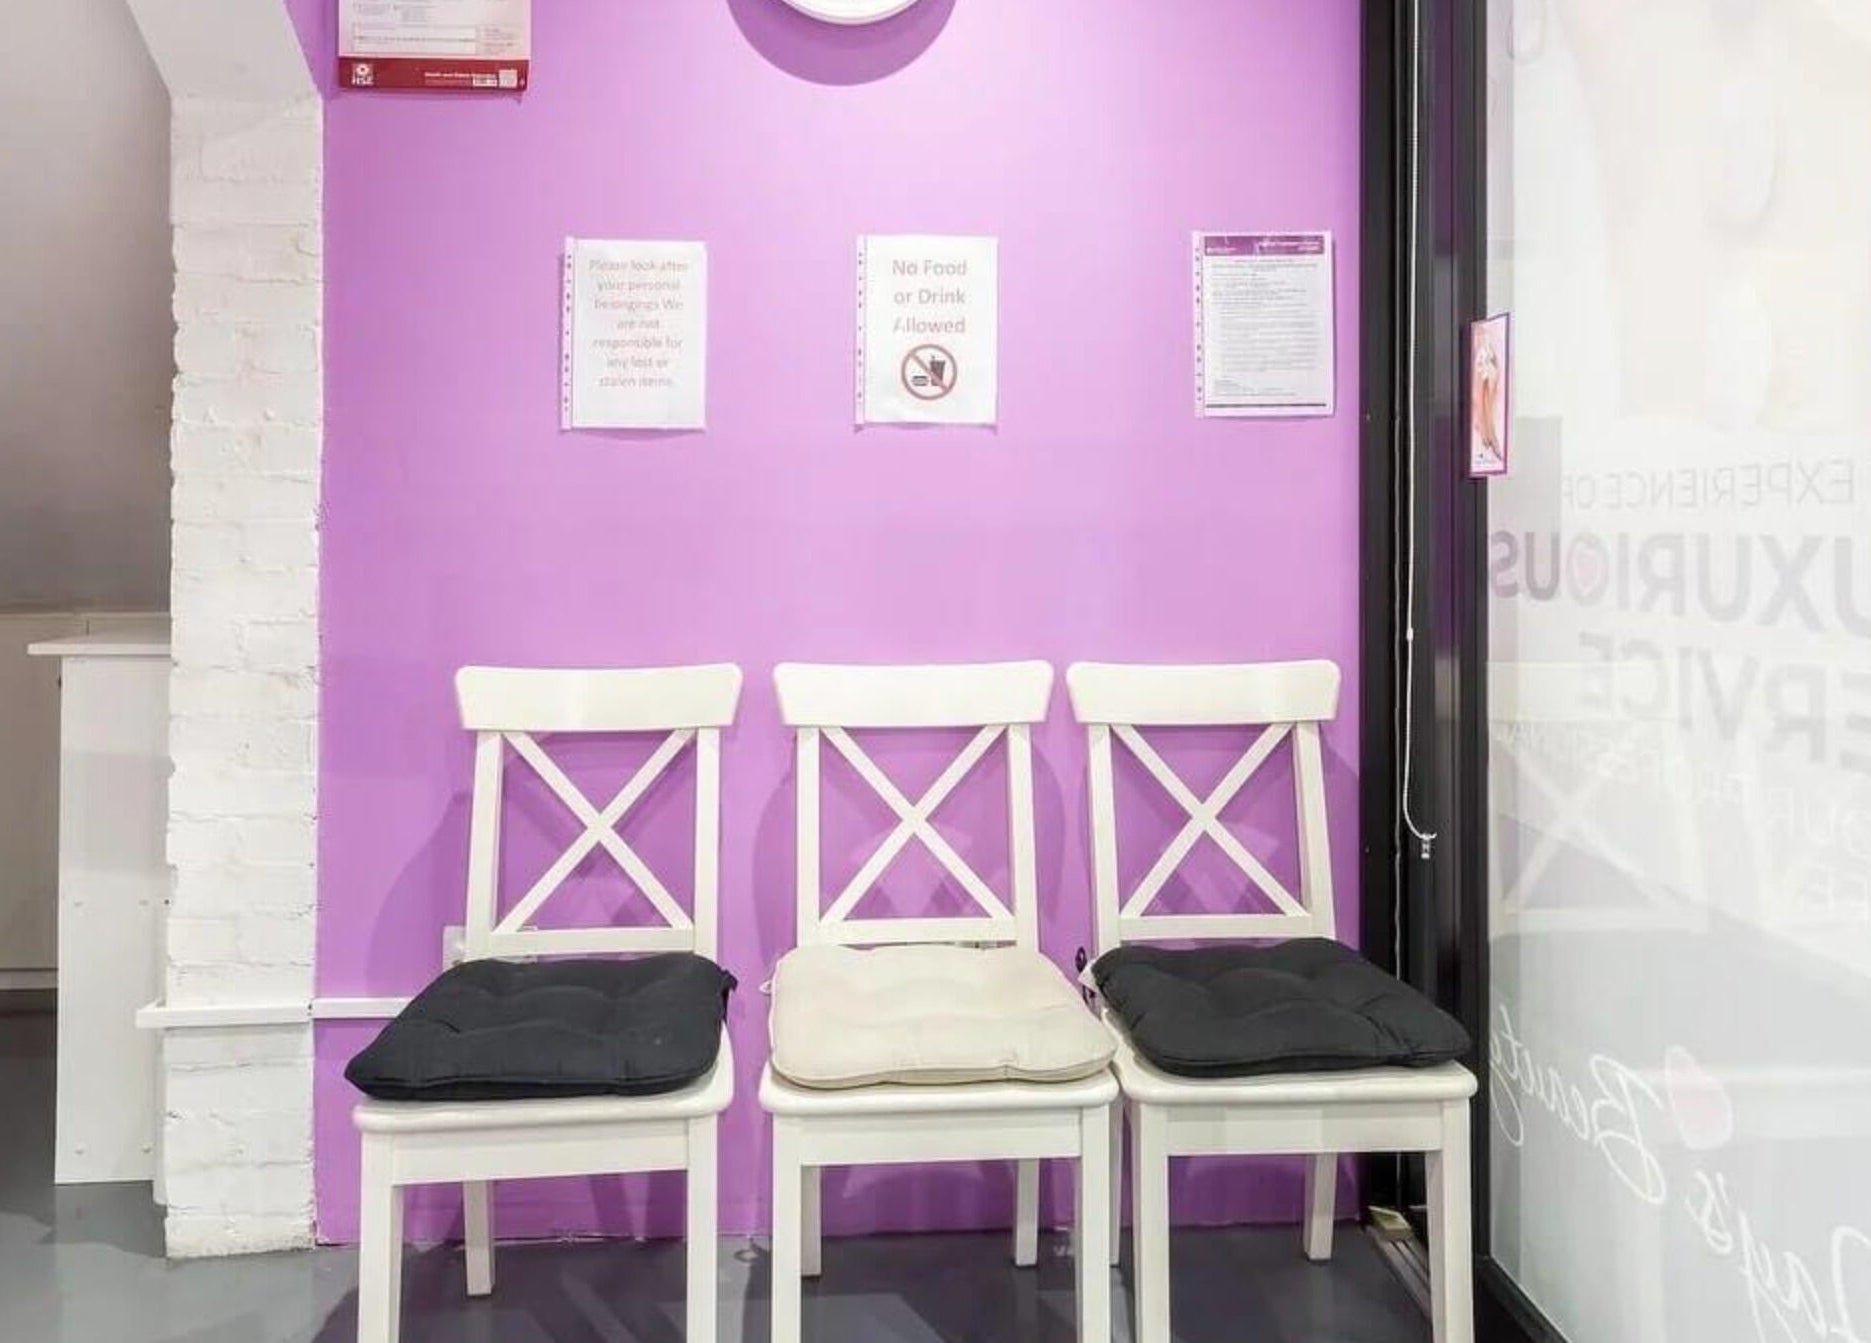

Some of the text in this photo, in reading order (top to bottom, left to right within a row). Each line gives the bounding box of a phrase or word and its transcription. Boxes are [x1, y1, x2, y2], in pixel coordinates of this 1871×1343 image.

[892, 259, 968, 276] No Food
[893, 287, 966, 305] or Drink
[892, 315, 967, 334] Allowed
